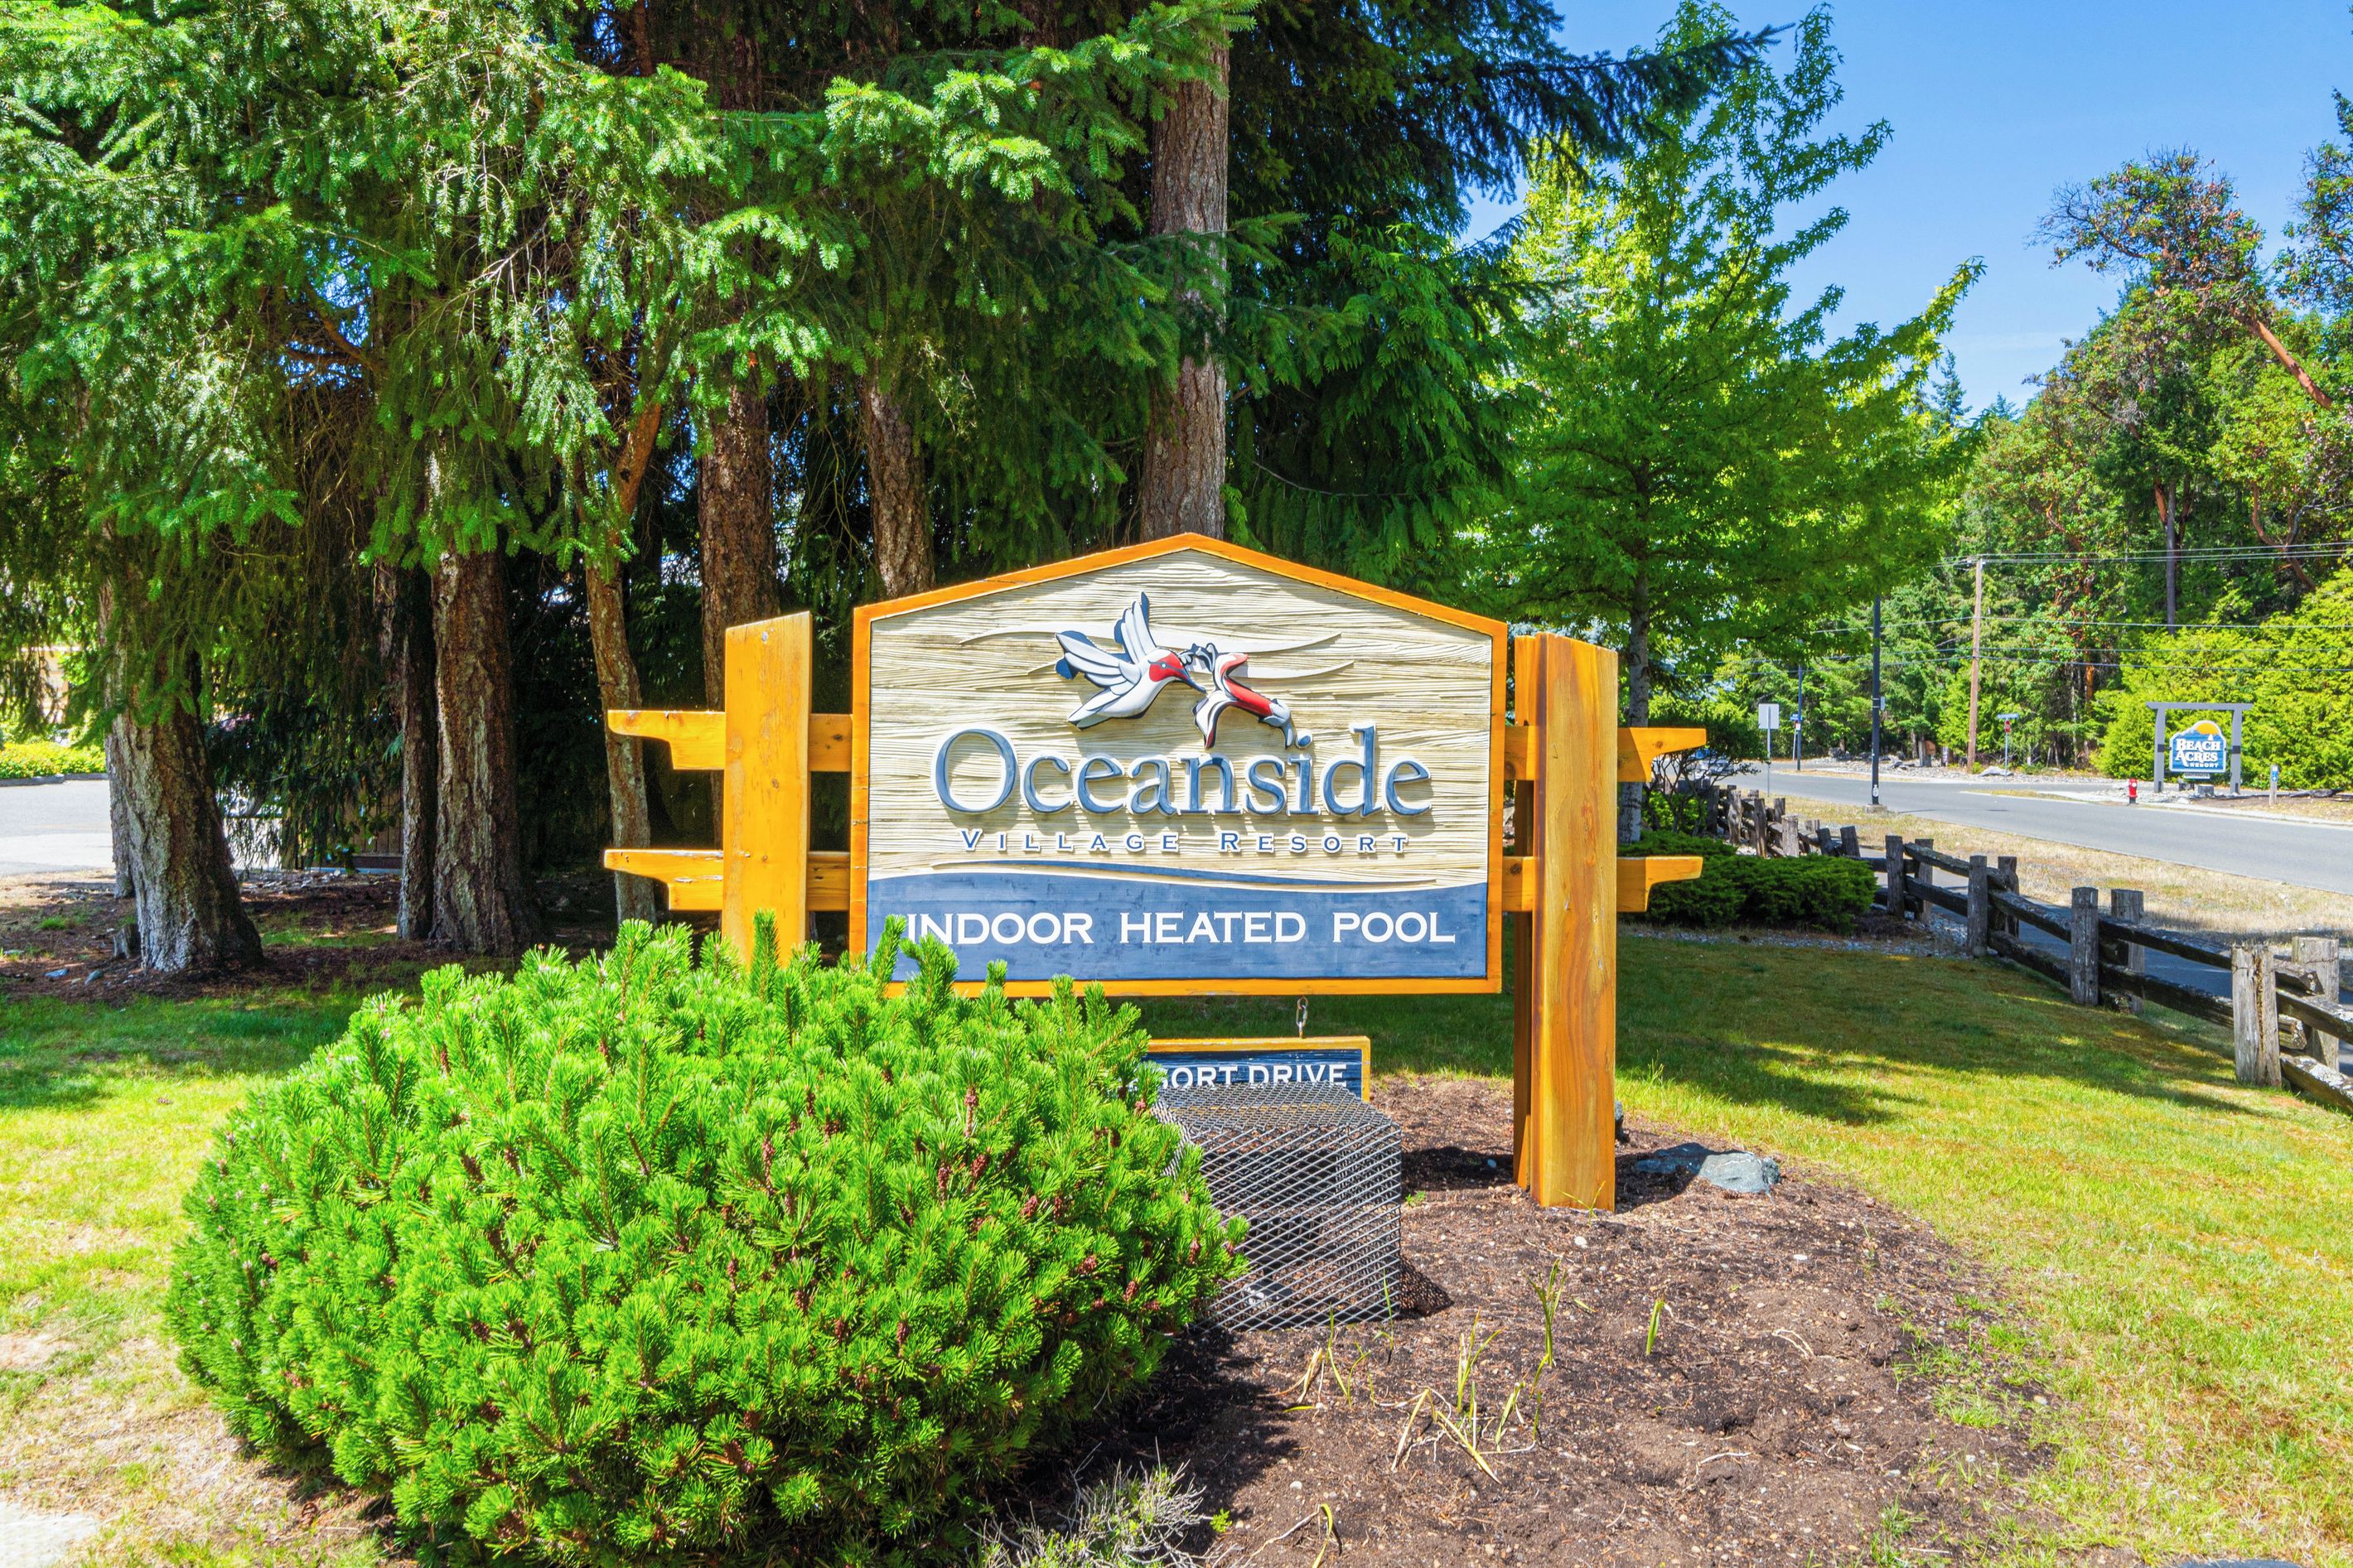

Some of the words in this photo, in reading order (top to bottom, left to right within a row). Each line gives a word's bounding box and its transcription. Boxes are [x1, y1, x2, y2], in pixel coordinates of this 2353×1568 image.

[2176, 738, 2221, 752] BEACH
[934, 721, 1432, 817] Oceanside
[2175, 750, 2218, 767] ACRES
[961, 829, 1178, 851] VILLAGE
[1220, 832, 1407, 852] RESORT
[906, 912, 1094, 945] INDOOR
[1119, 911, 1307, 944] HEATED
[1332, 912, 1456, 943] POOL
[1248, 1064, 1347, 1088] DRIVE
